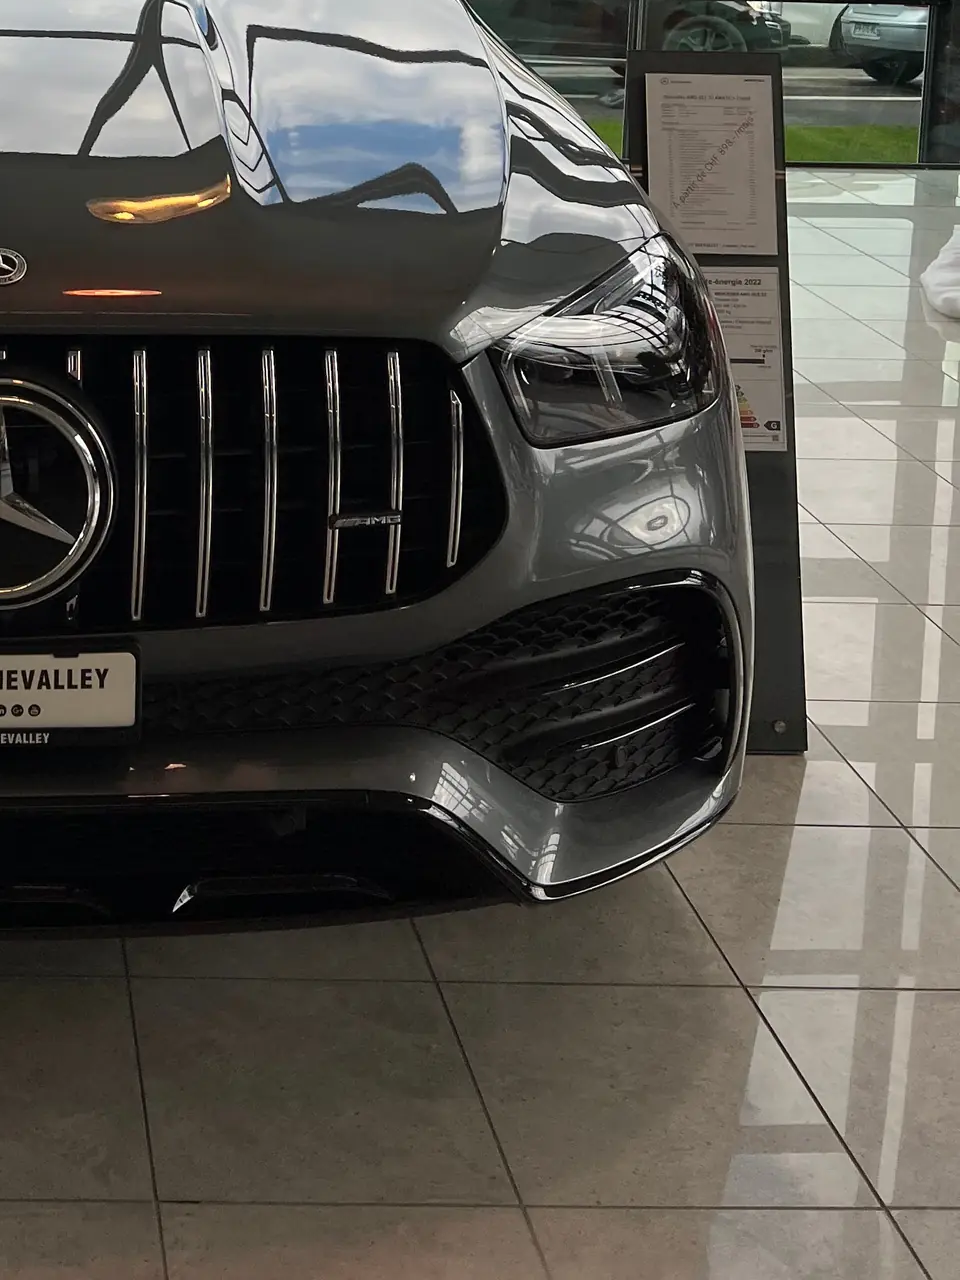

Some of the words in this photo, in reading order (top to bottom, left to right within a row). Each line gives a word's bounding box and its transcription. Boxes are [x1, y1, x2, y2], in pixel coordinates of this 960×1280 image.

[696, 170, 707, 182] de
[704, 154, 720, 171] CHF
[744, 278, 762, 286] 2022
